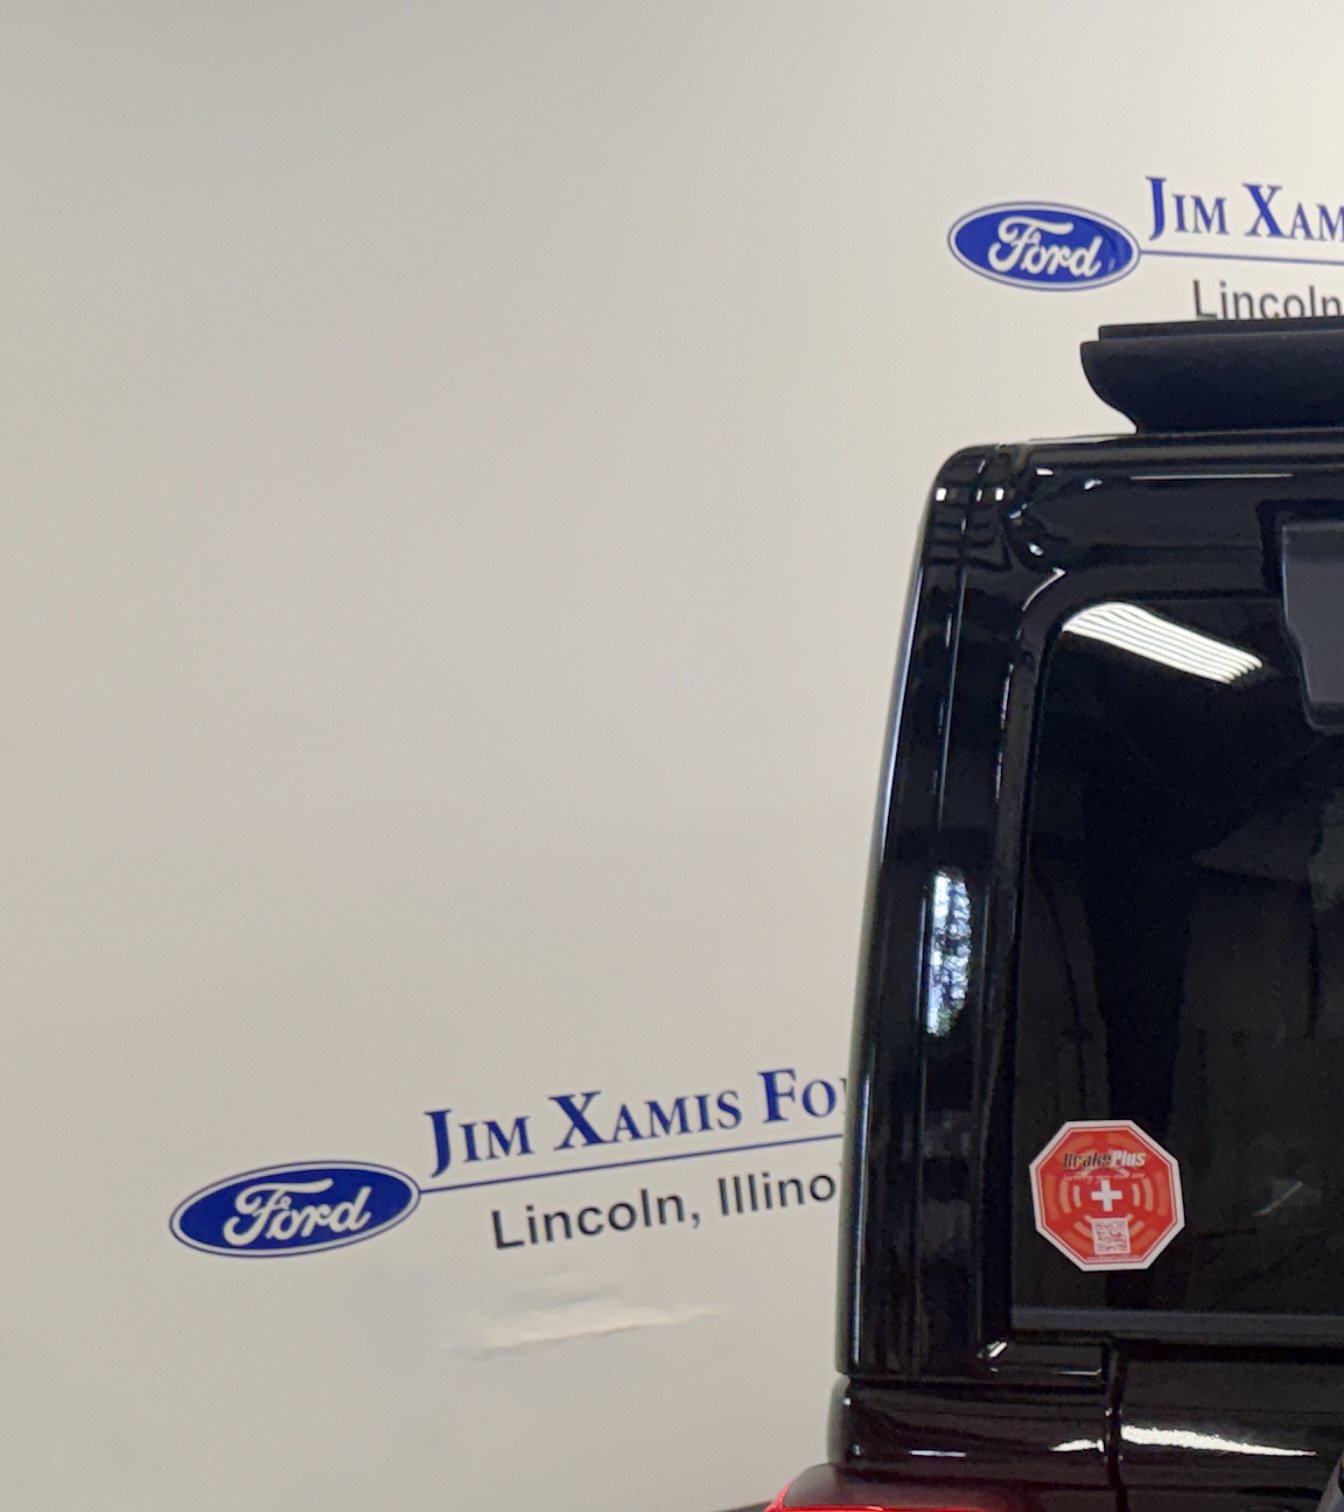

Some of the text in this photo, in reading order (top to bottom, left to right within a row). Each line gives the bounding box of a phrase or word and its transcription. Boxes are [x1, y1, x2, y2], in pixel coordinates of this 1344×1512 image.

[1144, 176, 1227, 242] JIM
[988, 215, 1102, 279] Ford
[423, 1067, 848, 1177] JIM XAMIS FO
[222, 1178, 373, 1246] Ford
[490, 1171, 843, 1250] Lincoln, Illino
